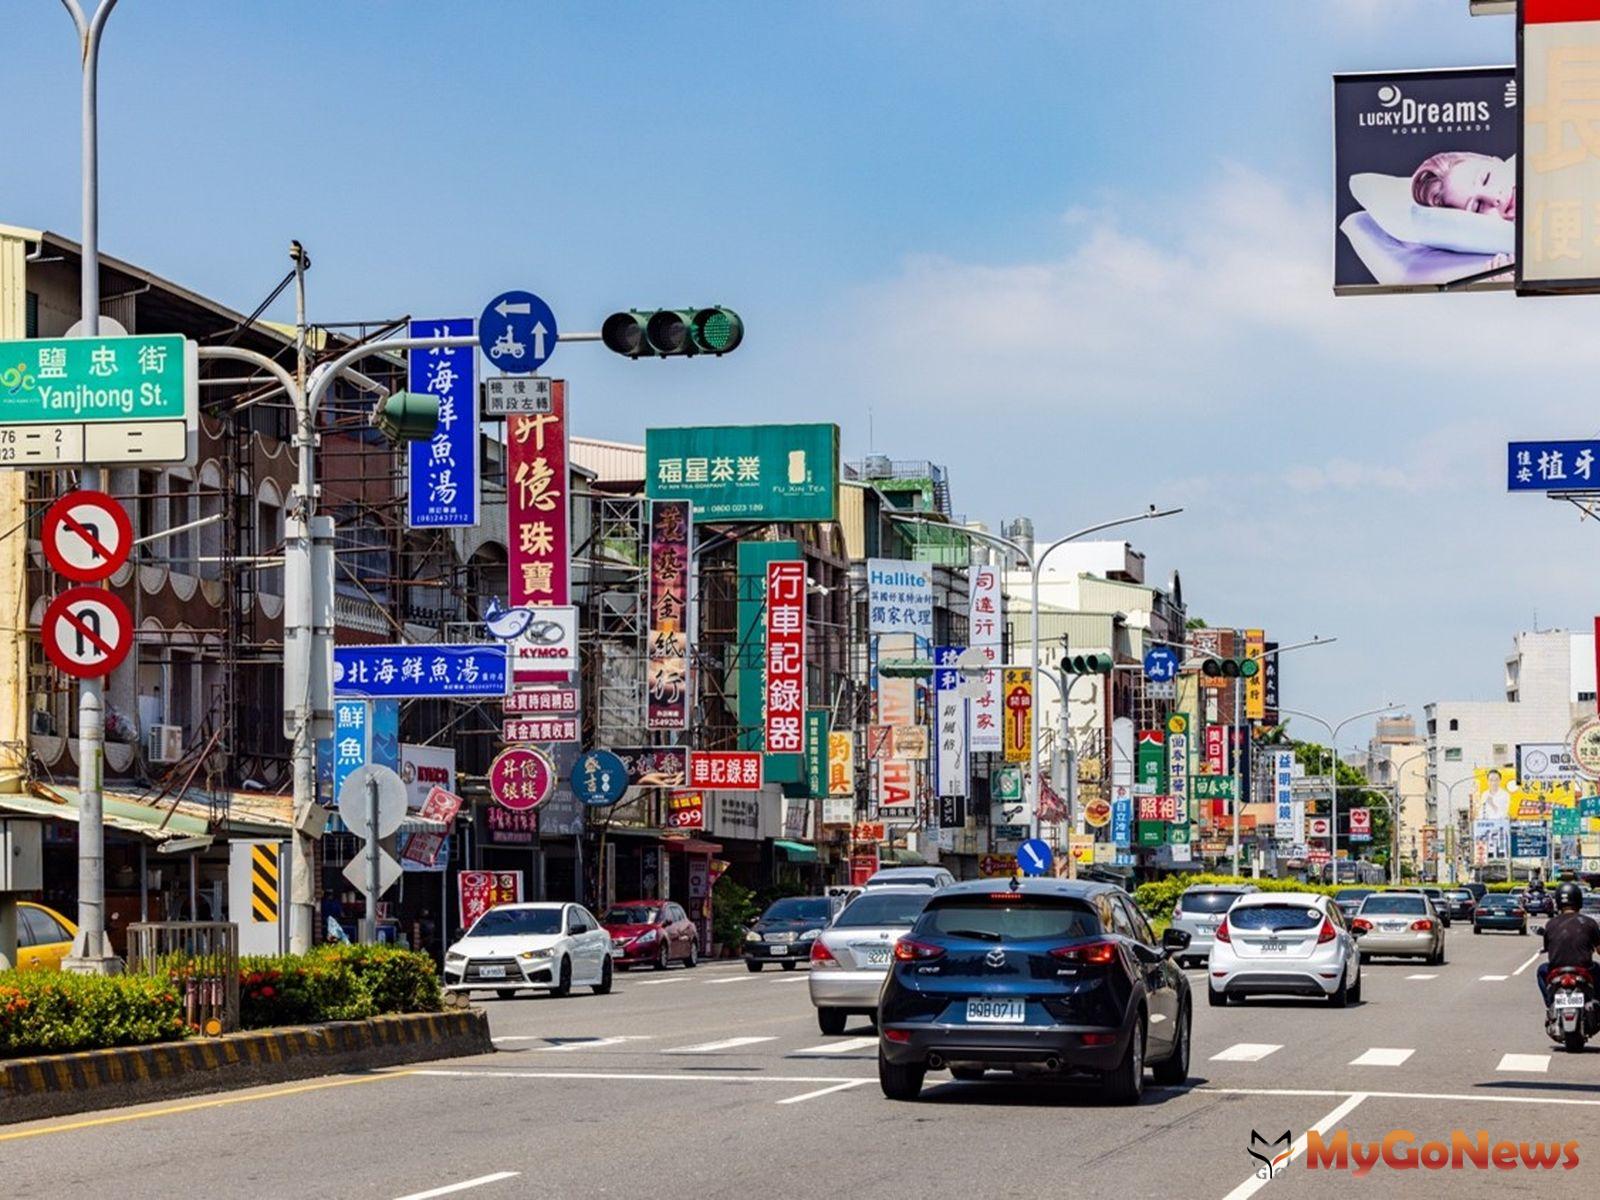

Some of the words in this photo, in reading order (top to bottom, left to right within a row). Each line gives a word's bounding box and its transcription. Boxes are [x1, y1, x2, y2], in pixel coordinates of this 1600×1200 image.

[37, 344, 168, 380] 鹽忠街
[38, 382, 133, 414] Yanjhong
[140, 379, 168, 407] St.
[658, 456, 760, 483] 福星茶業
[1537, 449, 1595, 480] 植牙
[808, 484, 826, 492] TEA
[871, 571, 926, 588] Hallite
[872, 607, 932, 625] 獨家代理
[519, 648, 569, 659] KYMCO
[770, 566, 801, 749] 行車記錄器
[348, 656, 480, 684] 北海鮮魚湯
[338, 706, 364, 787] 鮮魚
[691, 759, 758, 783] 車記錄器
[668, 810, 702, 827] 699
[1141, 797, 1175, 819] 照相
